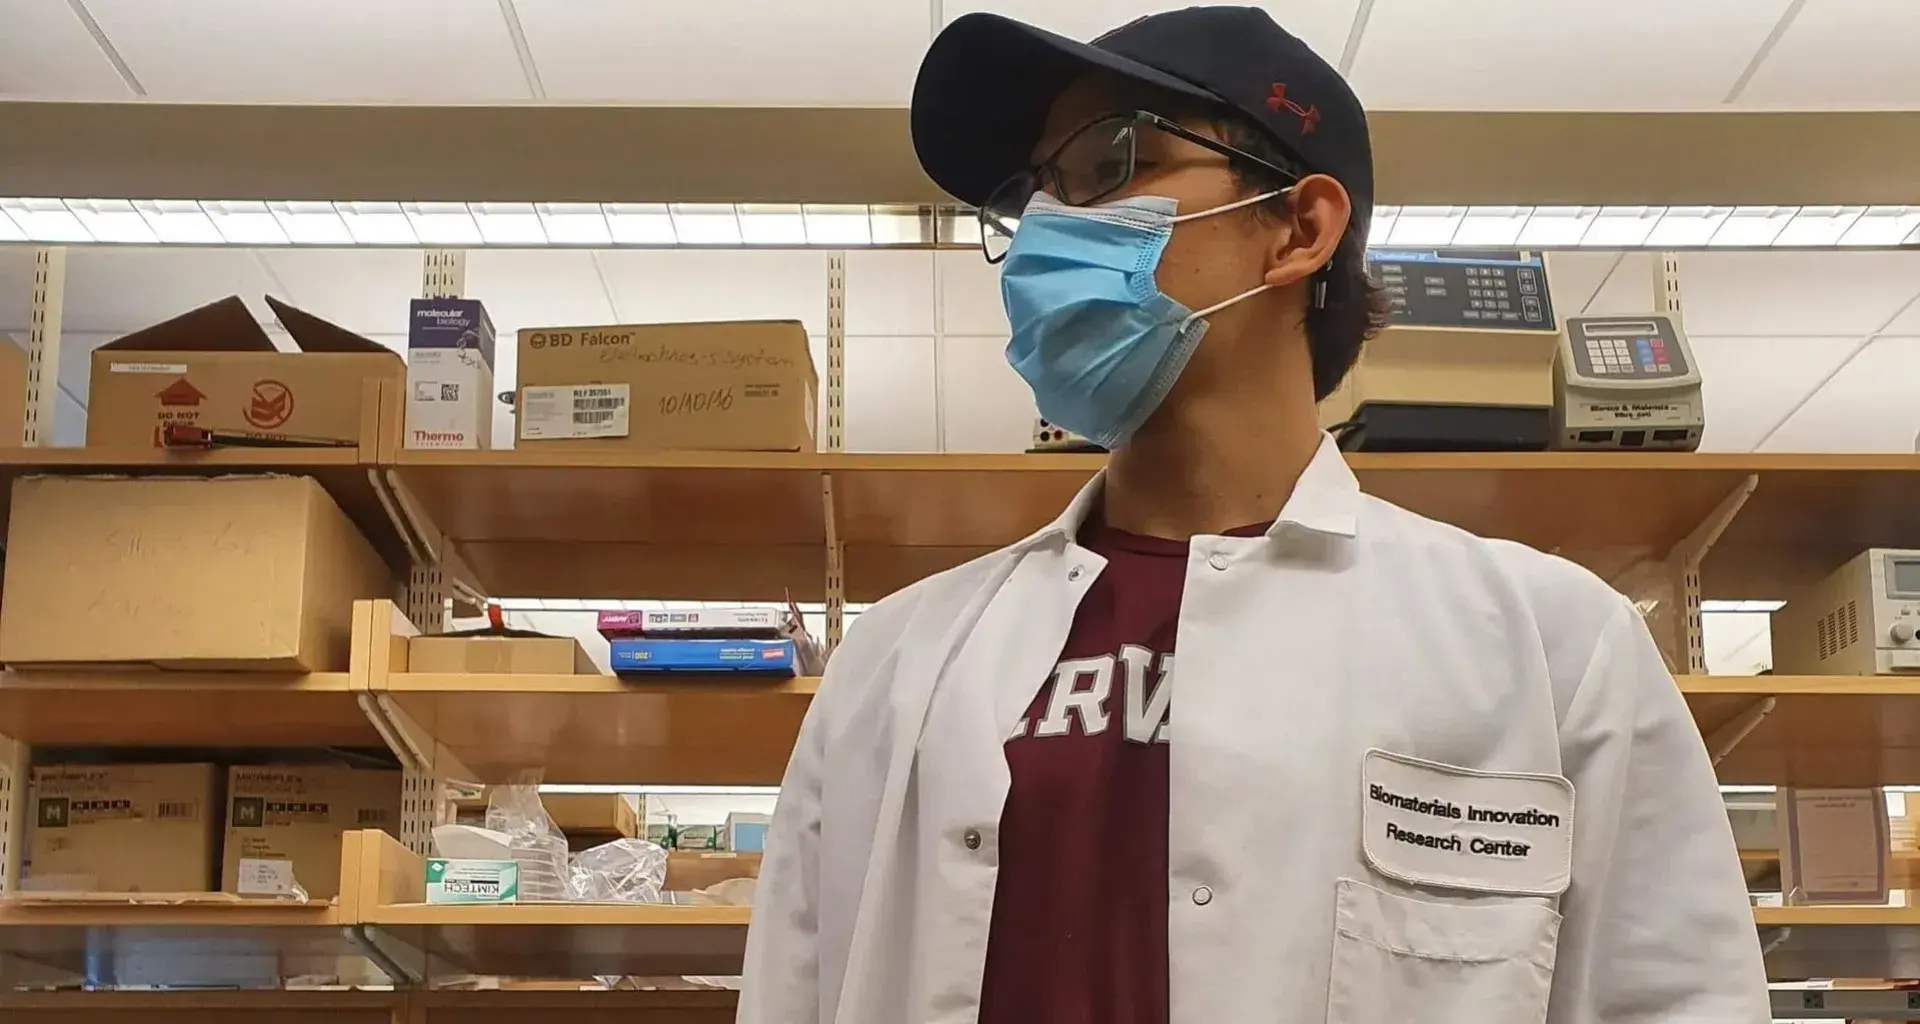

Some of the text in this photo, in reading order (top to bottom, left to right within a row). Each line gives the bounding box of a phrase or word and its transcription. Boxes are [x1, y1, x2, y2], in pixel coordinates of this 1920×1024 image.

[417, 309, 464, 318] molecular
[436, 317, 471, 327] biology
[549, 333, 572, 347] BD
[413, 430, 464, 442] Thermo
[1005, 643, 1175, 747] RV
[1369, 783, 1559, 827] Biomaterials Innovation
[46, 805, 60, 820] M
[240, 805, 254, 820] M
[1386, 822, 1531, 857] Research Center
[444, 883, 499, 893] KIMTECH
